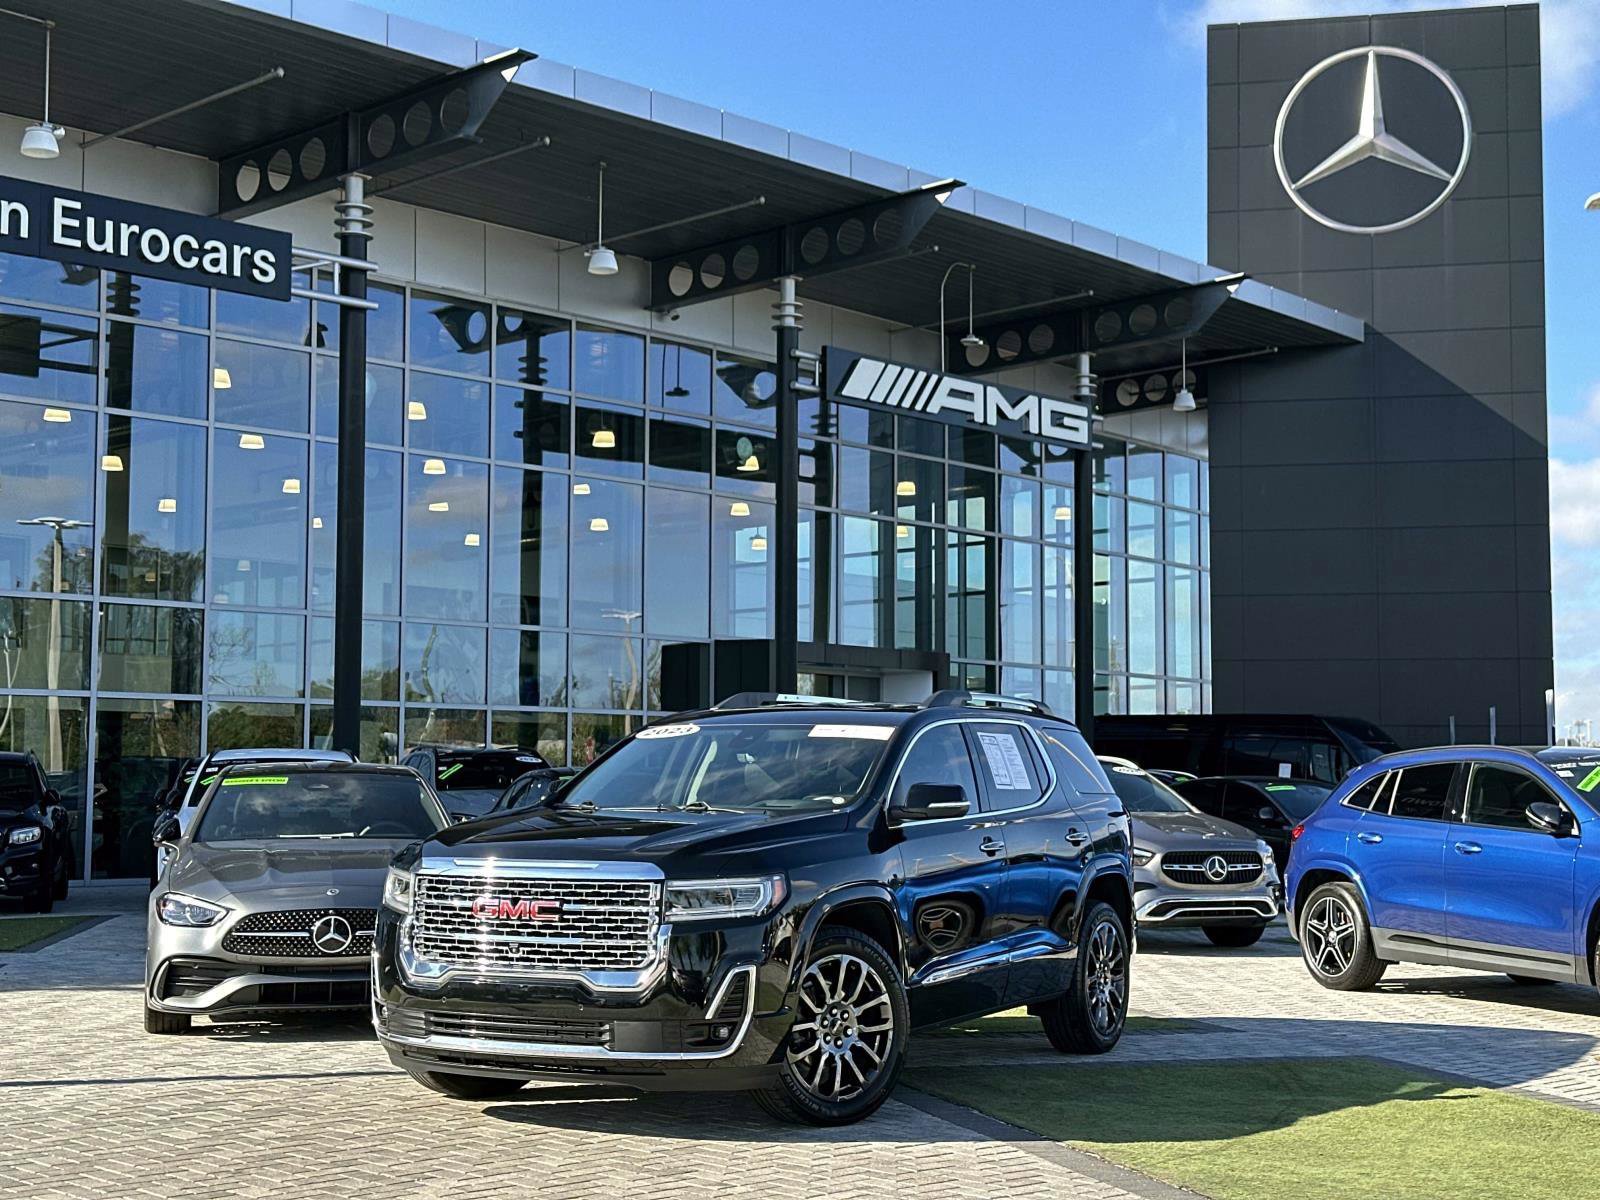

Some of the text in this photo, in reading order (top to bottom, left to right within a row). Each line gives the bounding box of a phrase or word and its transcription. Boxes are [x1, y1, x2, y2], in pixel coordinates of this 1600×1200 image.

[53, 197, 276, 283] Eurocars
[926, 376, 1088, 444] AMG
[642, 726, 693, 736] 2023
[472, 897, 560, 921] GMC
